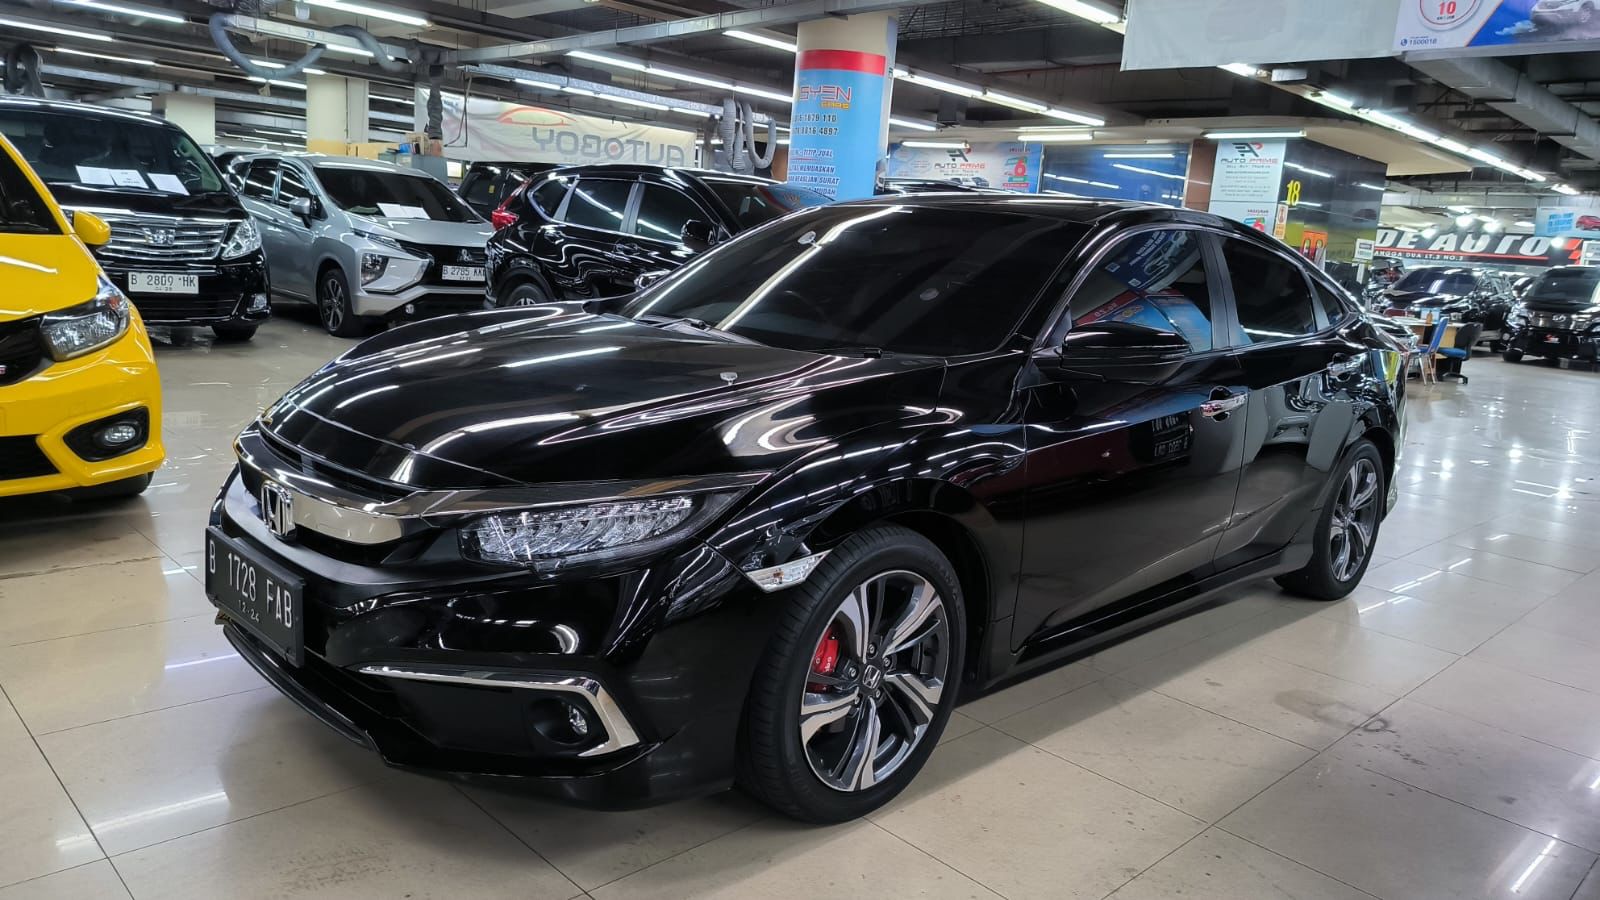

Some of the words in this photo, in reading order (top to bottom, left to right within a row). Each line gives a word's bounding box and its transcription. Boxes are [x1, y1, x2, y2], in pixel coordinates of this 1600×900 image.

[1287, 180, 1301, 206] 18
[1429, 233, 1550, 256] AUTO
[131, 274, 138, 285] B
[209, 539, 216, 574] B
[227, 552, 256, 602] 1728
[266, 578, 292, 629] FAB
